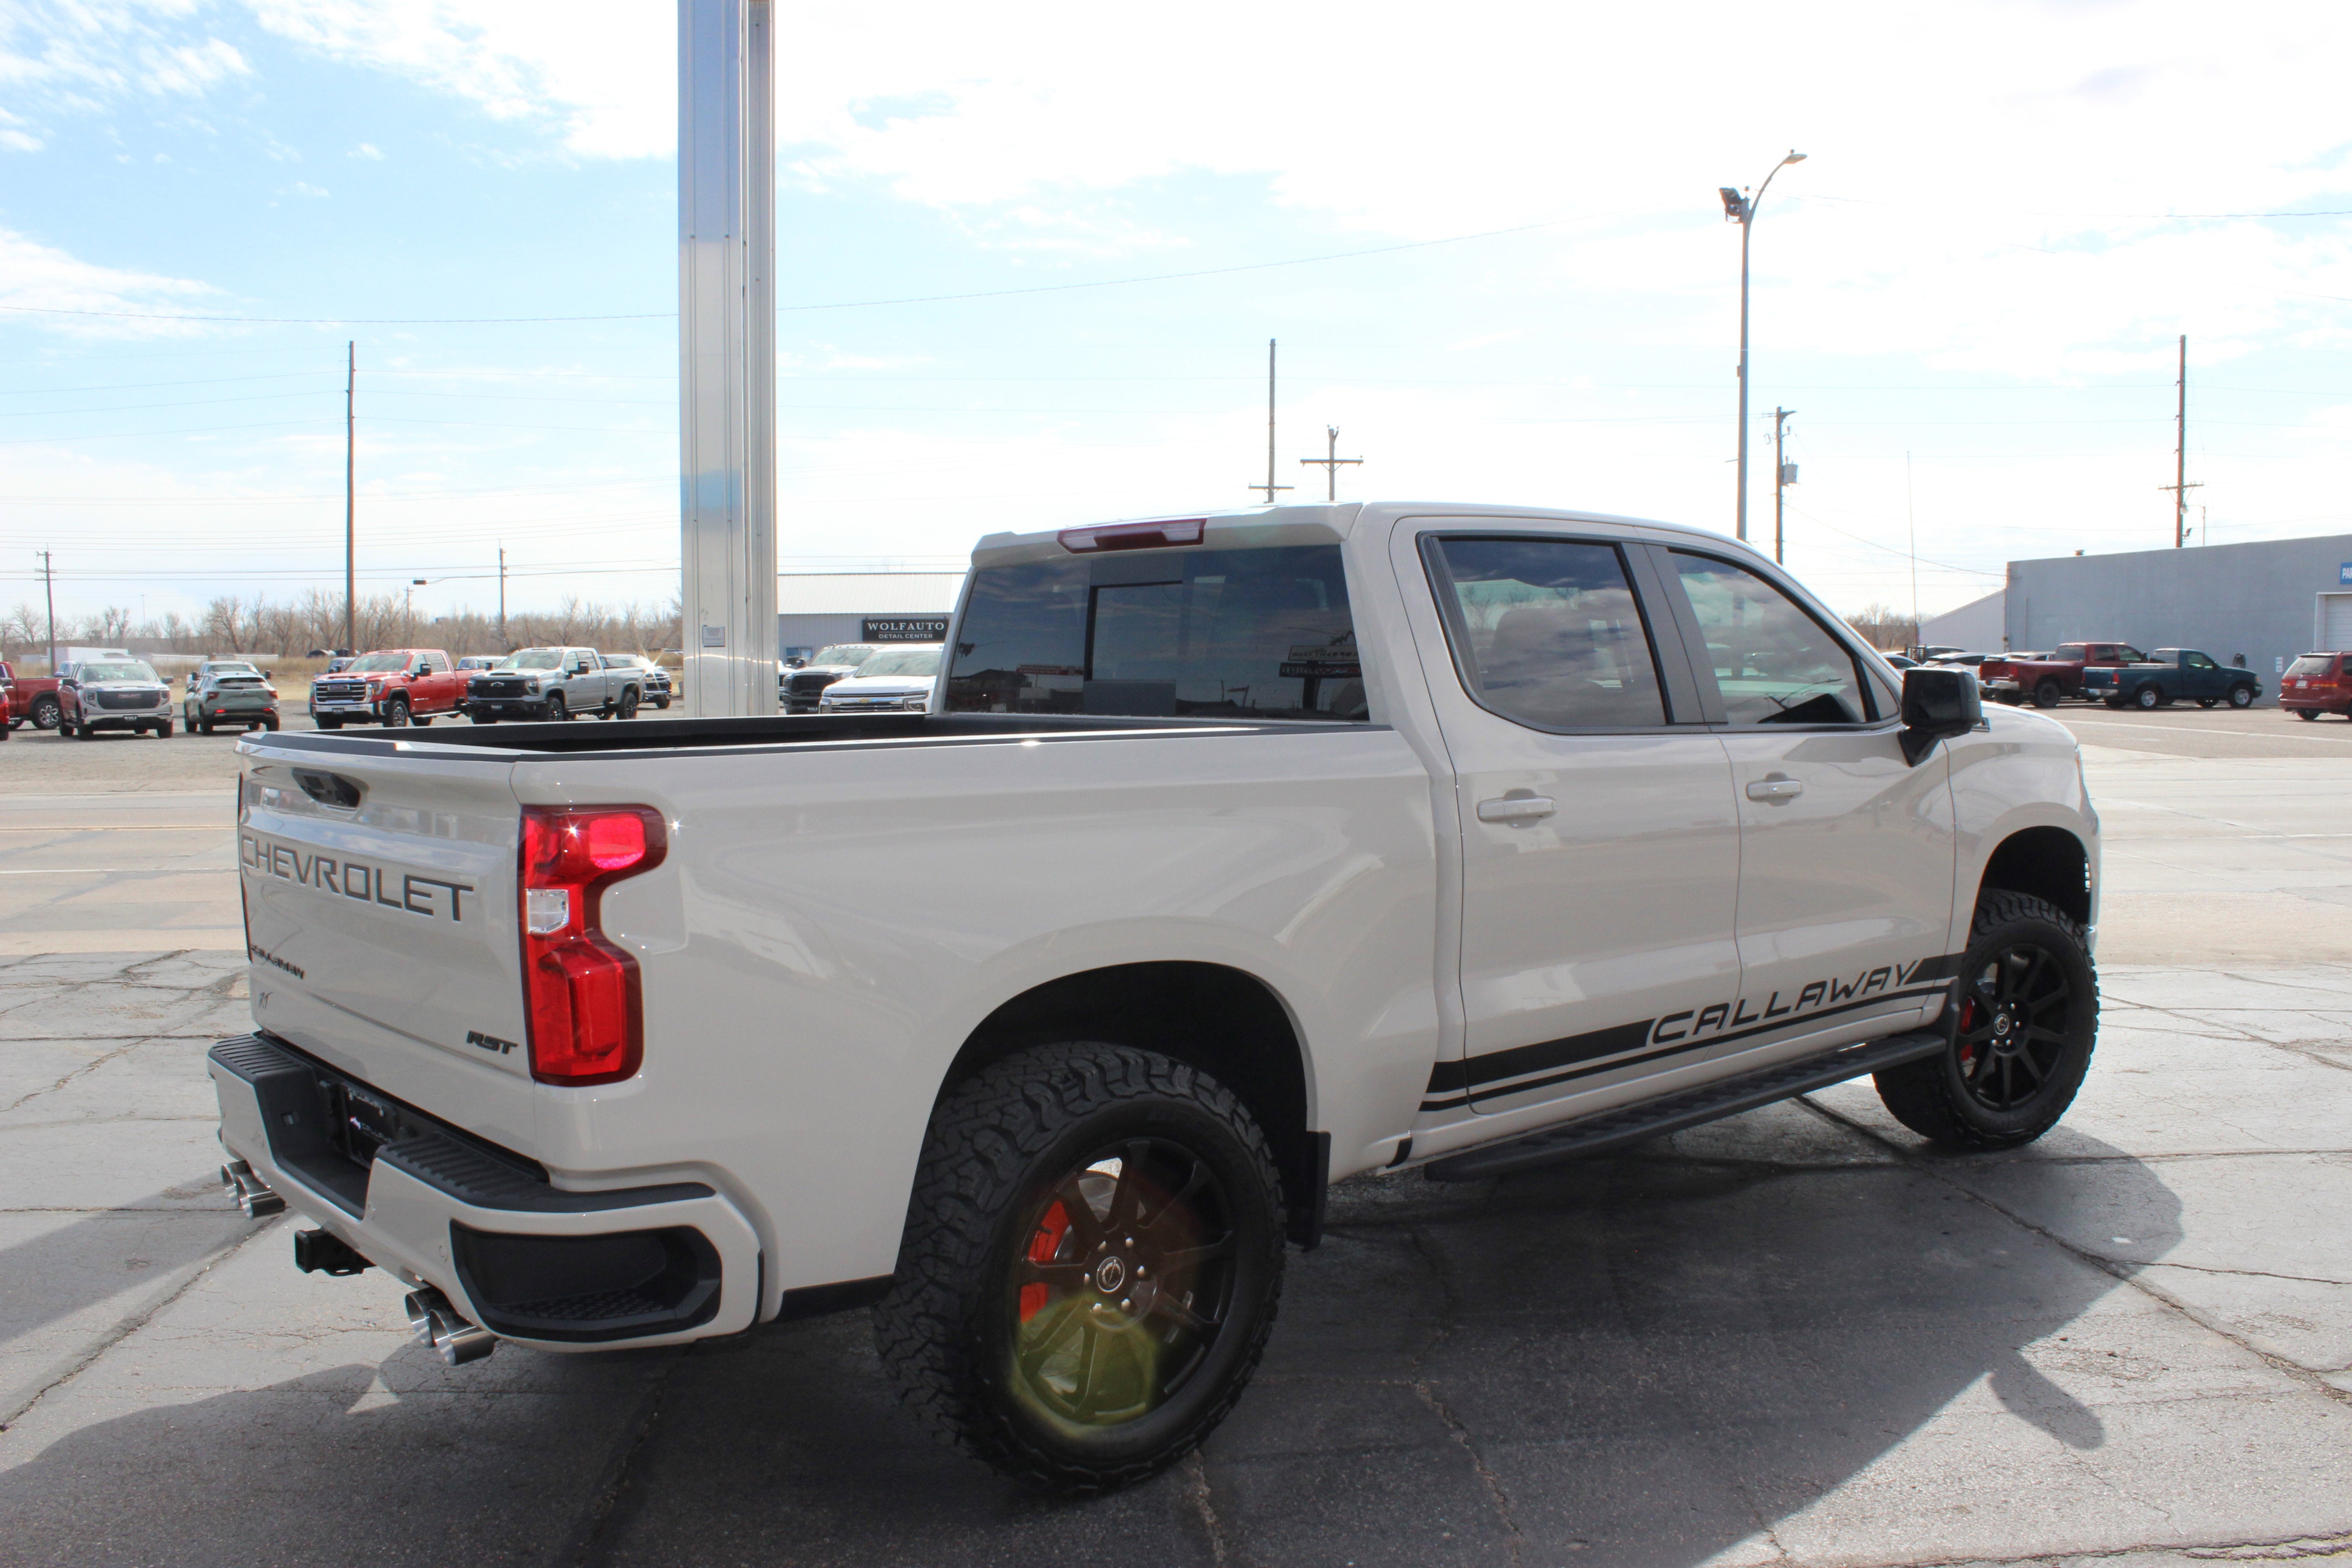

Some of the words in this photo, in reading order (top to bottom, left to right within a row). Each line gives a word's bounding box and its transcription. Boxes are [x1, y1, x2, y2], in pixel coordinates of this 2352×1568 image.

[242, 834, 474, 921] CHEVROLET
[466, 1030, 518, 1054] RST
[1652, 960, 1918, 1044] CALLAWAY
